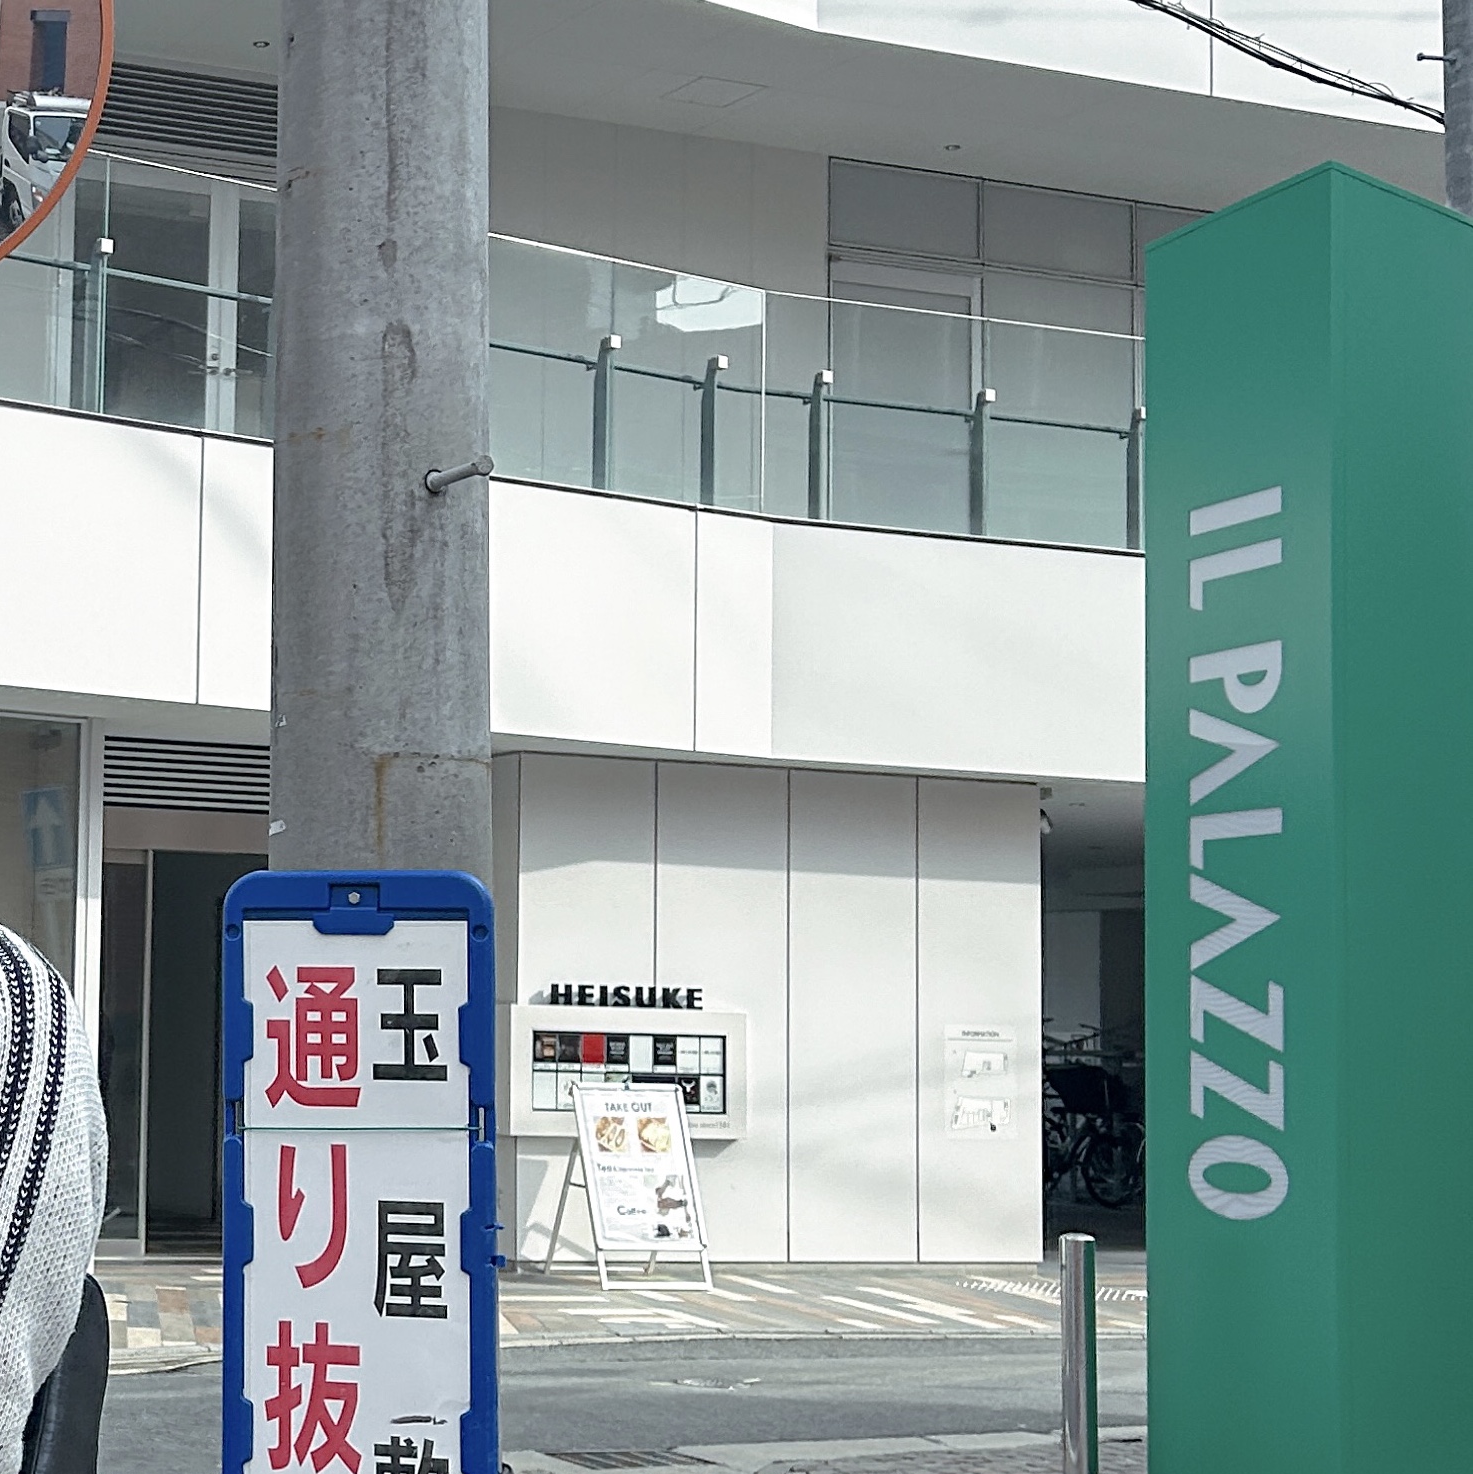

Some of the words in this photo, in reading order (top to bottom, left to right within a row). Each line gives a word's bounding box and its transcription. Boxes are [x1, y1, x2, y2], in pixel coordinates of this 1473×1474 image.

[1189, 485, 1282, 612] IL
[1188, 640, 1289, 1221] PALAZZO
[550, 984, 703, 1010] HEISUKE
[605, 1102, 629, 1112] TAKE
[631, 1102, 652, 1113] OUT
